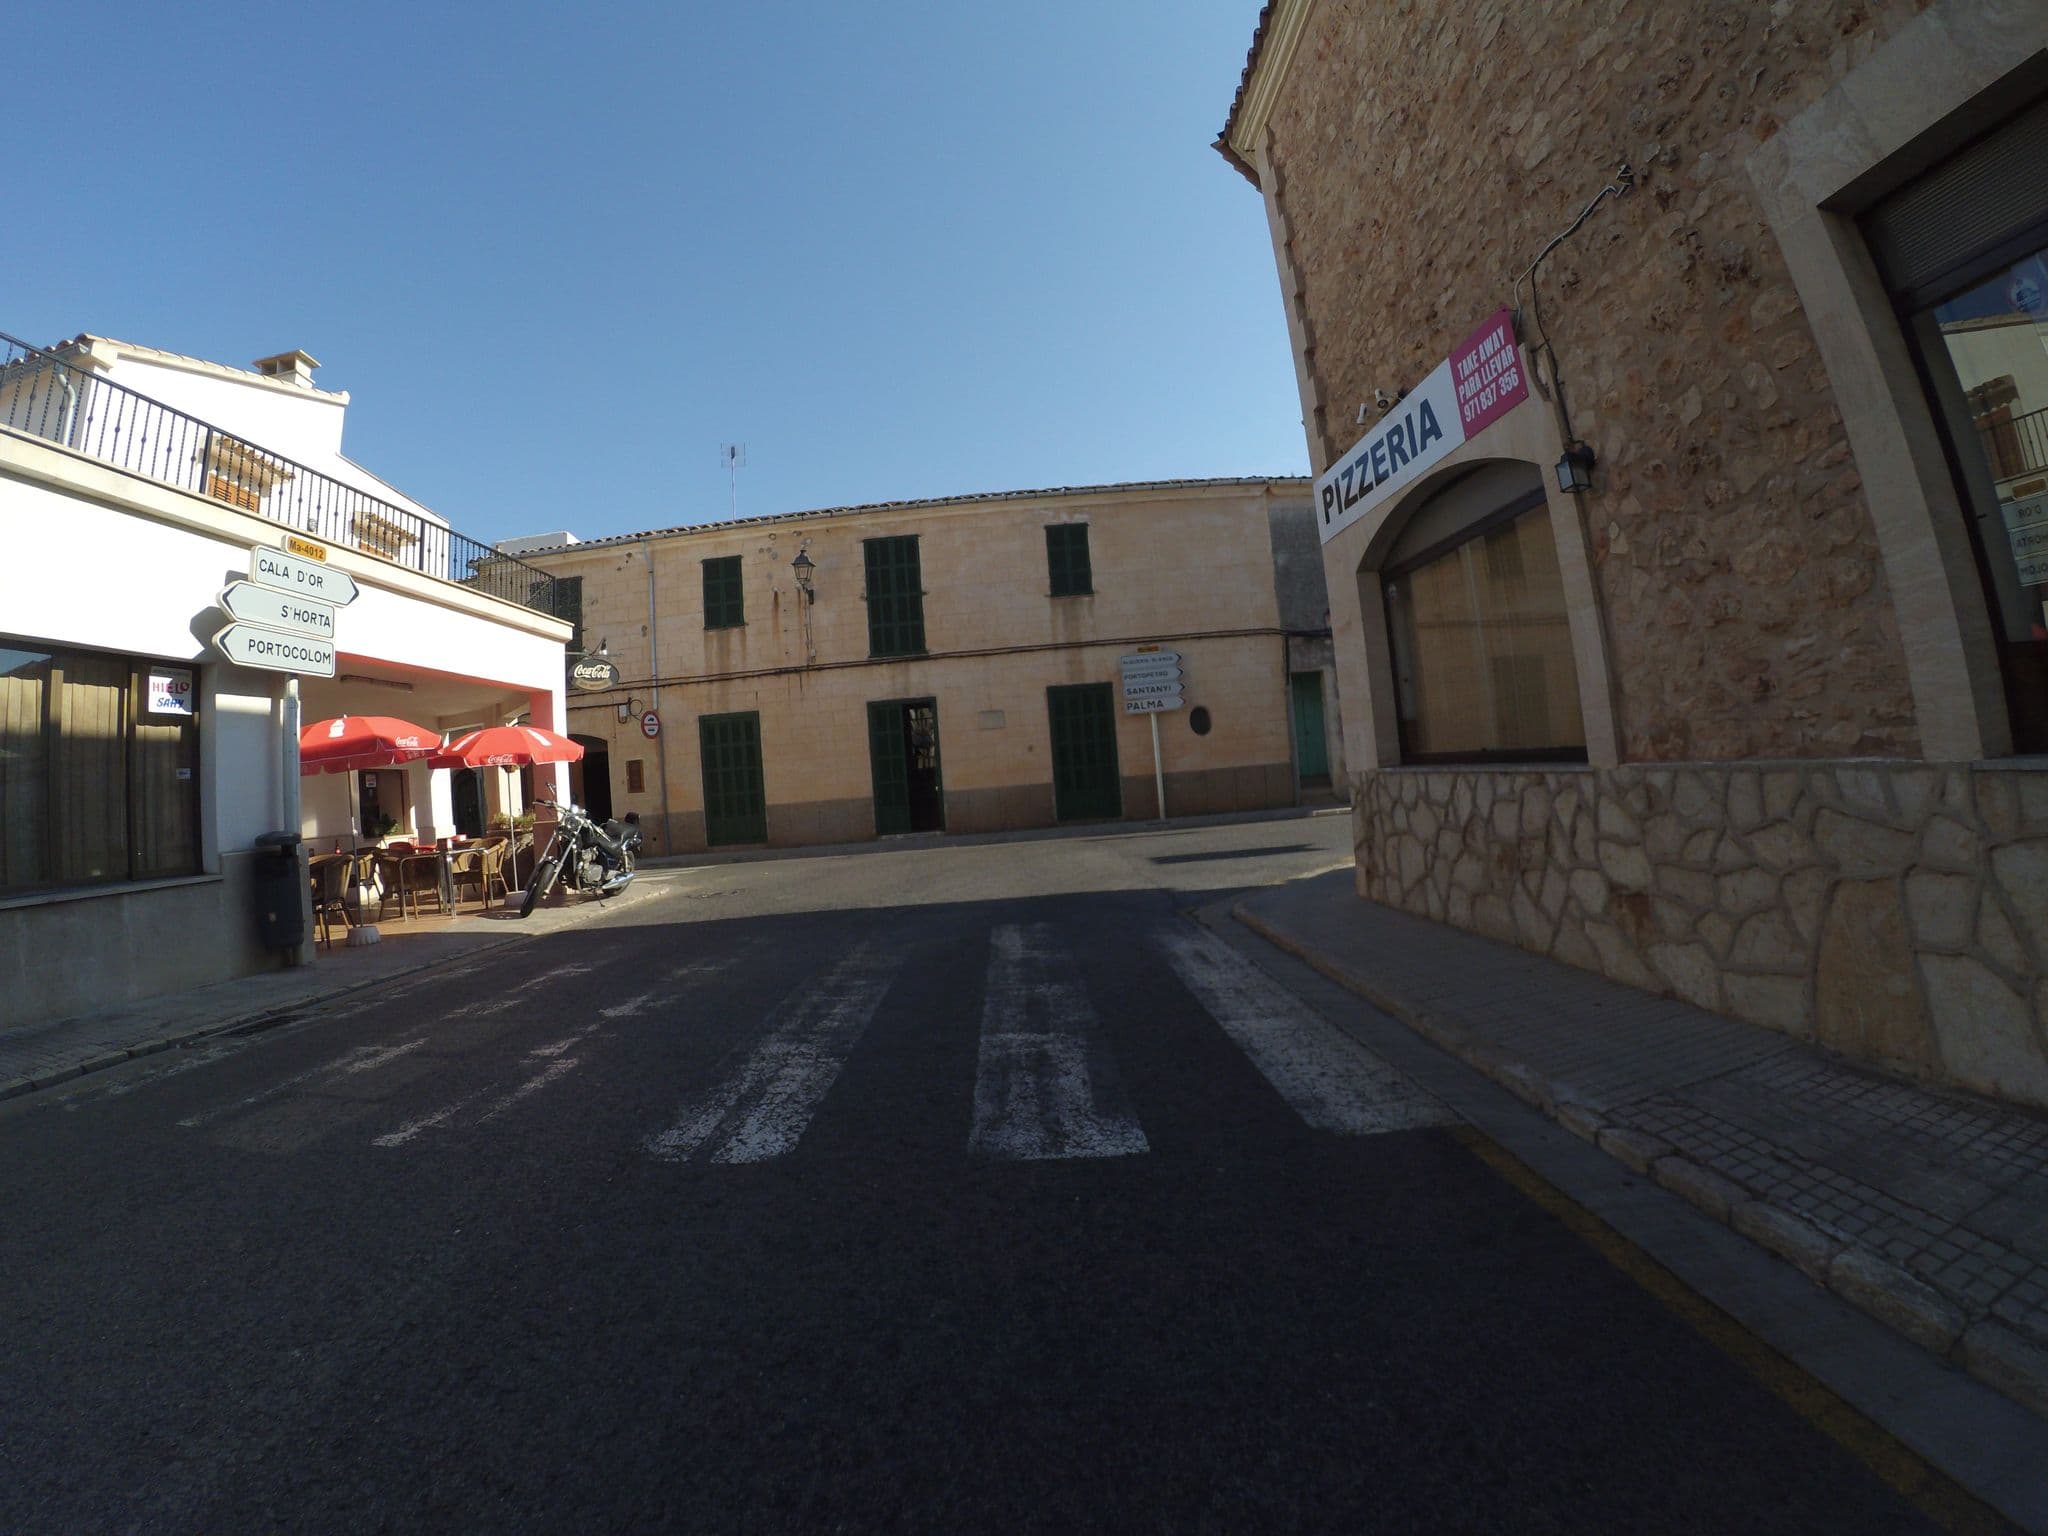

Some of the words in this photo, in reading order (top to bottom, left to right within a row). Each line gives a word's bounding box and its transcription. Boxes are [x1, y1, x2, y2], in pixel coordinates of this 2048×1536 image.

[1457, 350, 1479, 380] TAKE
[1479, 325, 1505, 363] AWAY
[1458, 372, 1482, 403] PARA
[1481, 344, 1515, 385] LLEVAR
[1464, 397, 1480, 422] 971
[1480, 382, 1497, 410] 837
[1499, 367, 1519, 396] 356
[1322, 398, 1443, 525] PIZZERIA
[289, 539, 325, 559] Ma-4012
[259, 559, 290, 579] CALA
[297, 570, 324, 589] D'OR
[281, 605, 331, 628] S'HORTA
[248, 638, 331, 665] PORTOCOLOM
[152, 681, 190, 694] HIELO
[1127, 700, 1164, 711] PALMA
